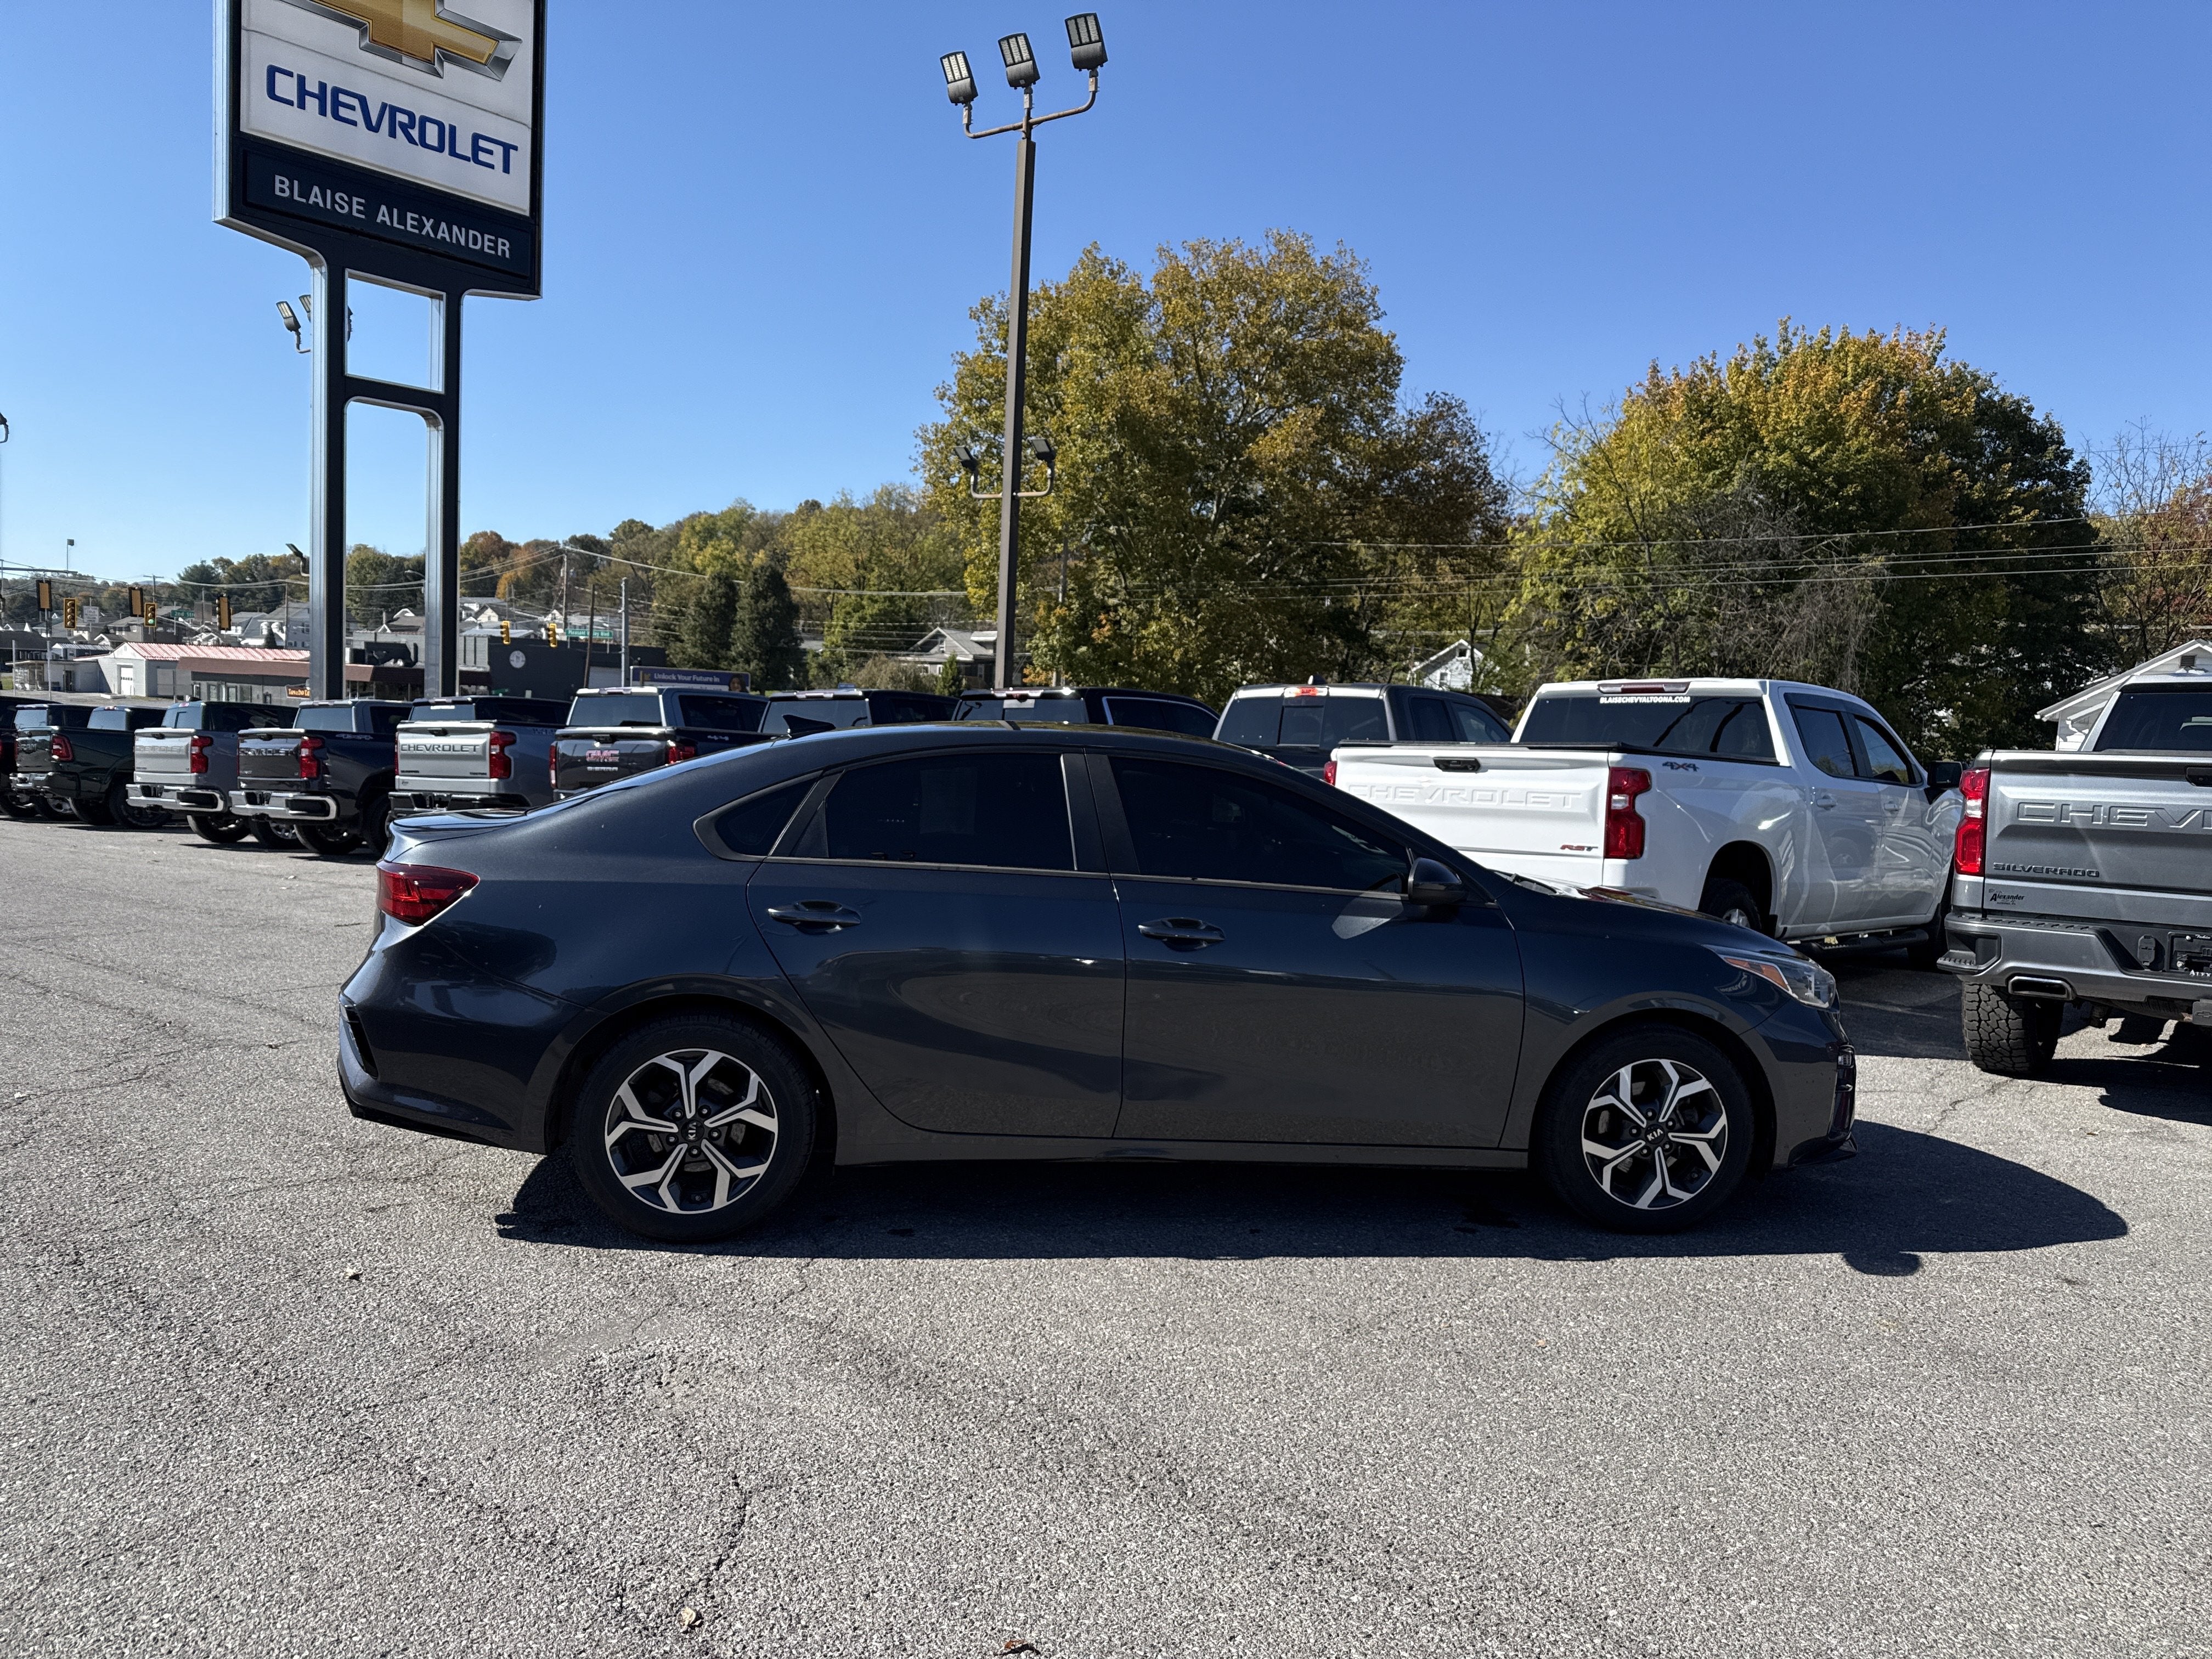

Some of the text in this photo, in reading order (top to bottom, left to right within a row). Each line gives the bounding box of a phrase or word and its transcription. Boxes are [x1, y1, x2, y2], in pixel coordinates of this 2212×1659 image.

[266, 64, 518, 174] CHEVROLET
[274, 174, 511, 258] BLAISE ALEXANDER
[401, 744, 480, 752] CHEVROLET
[586, 750, 619, 762] GMC
[1348, 784, 1582, 809] CHEVROLET
[2017, 802, 2212, 830] CHEV
[1993, 862, 2100, 878] SILVERADO
[1990, 893, 2025, 901] Alexander
[688, 1122, 697, 1140] KIA
[1646, 1128, 1663, 1141] KIA
